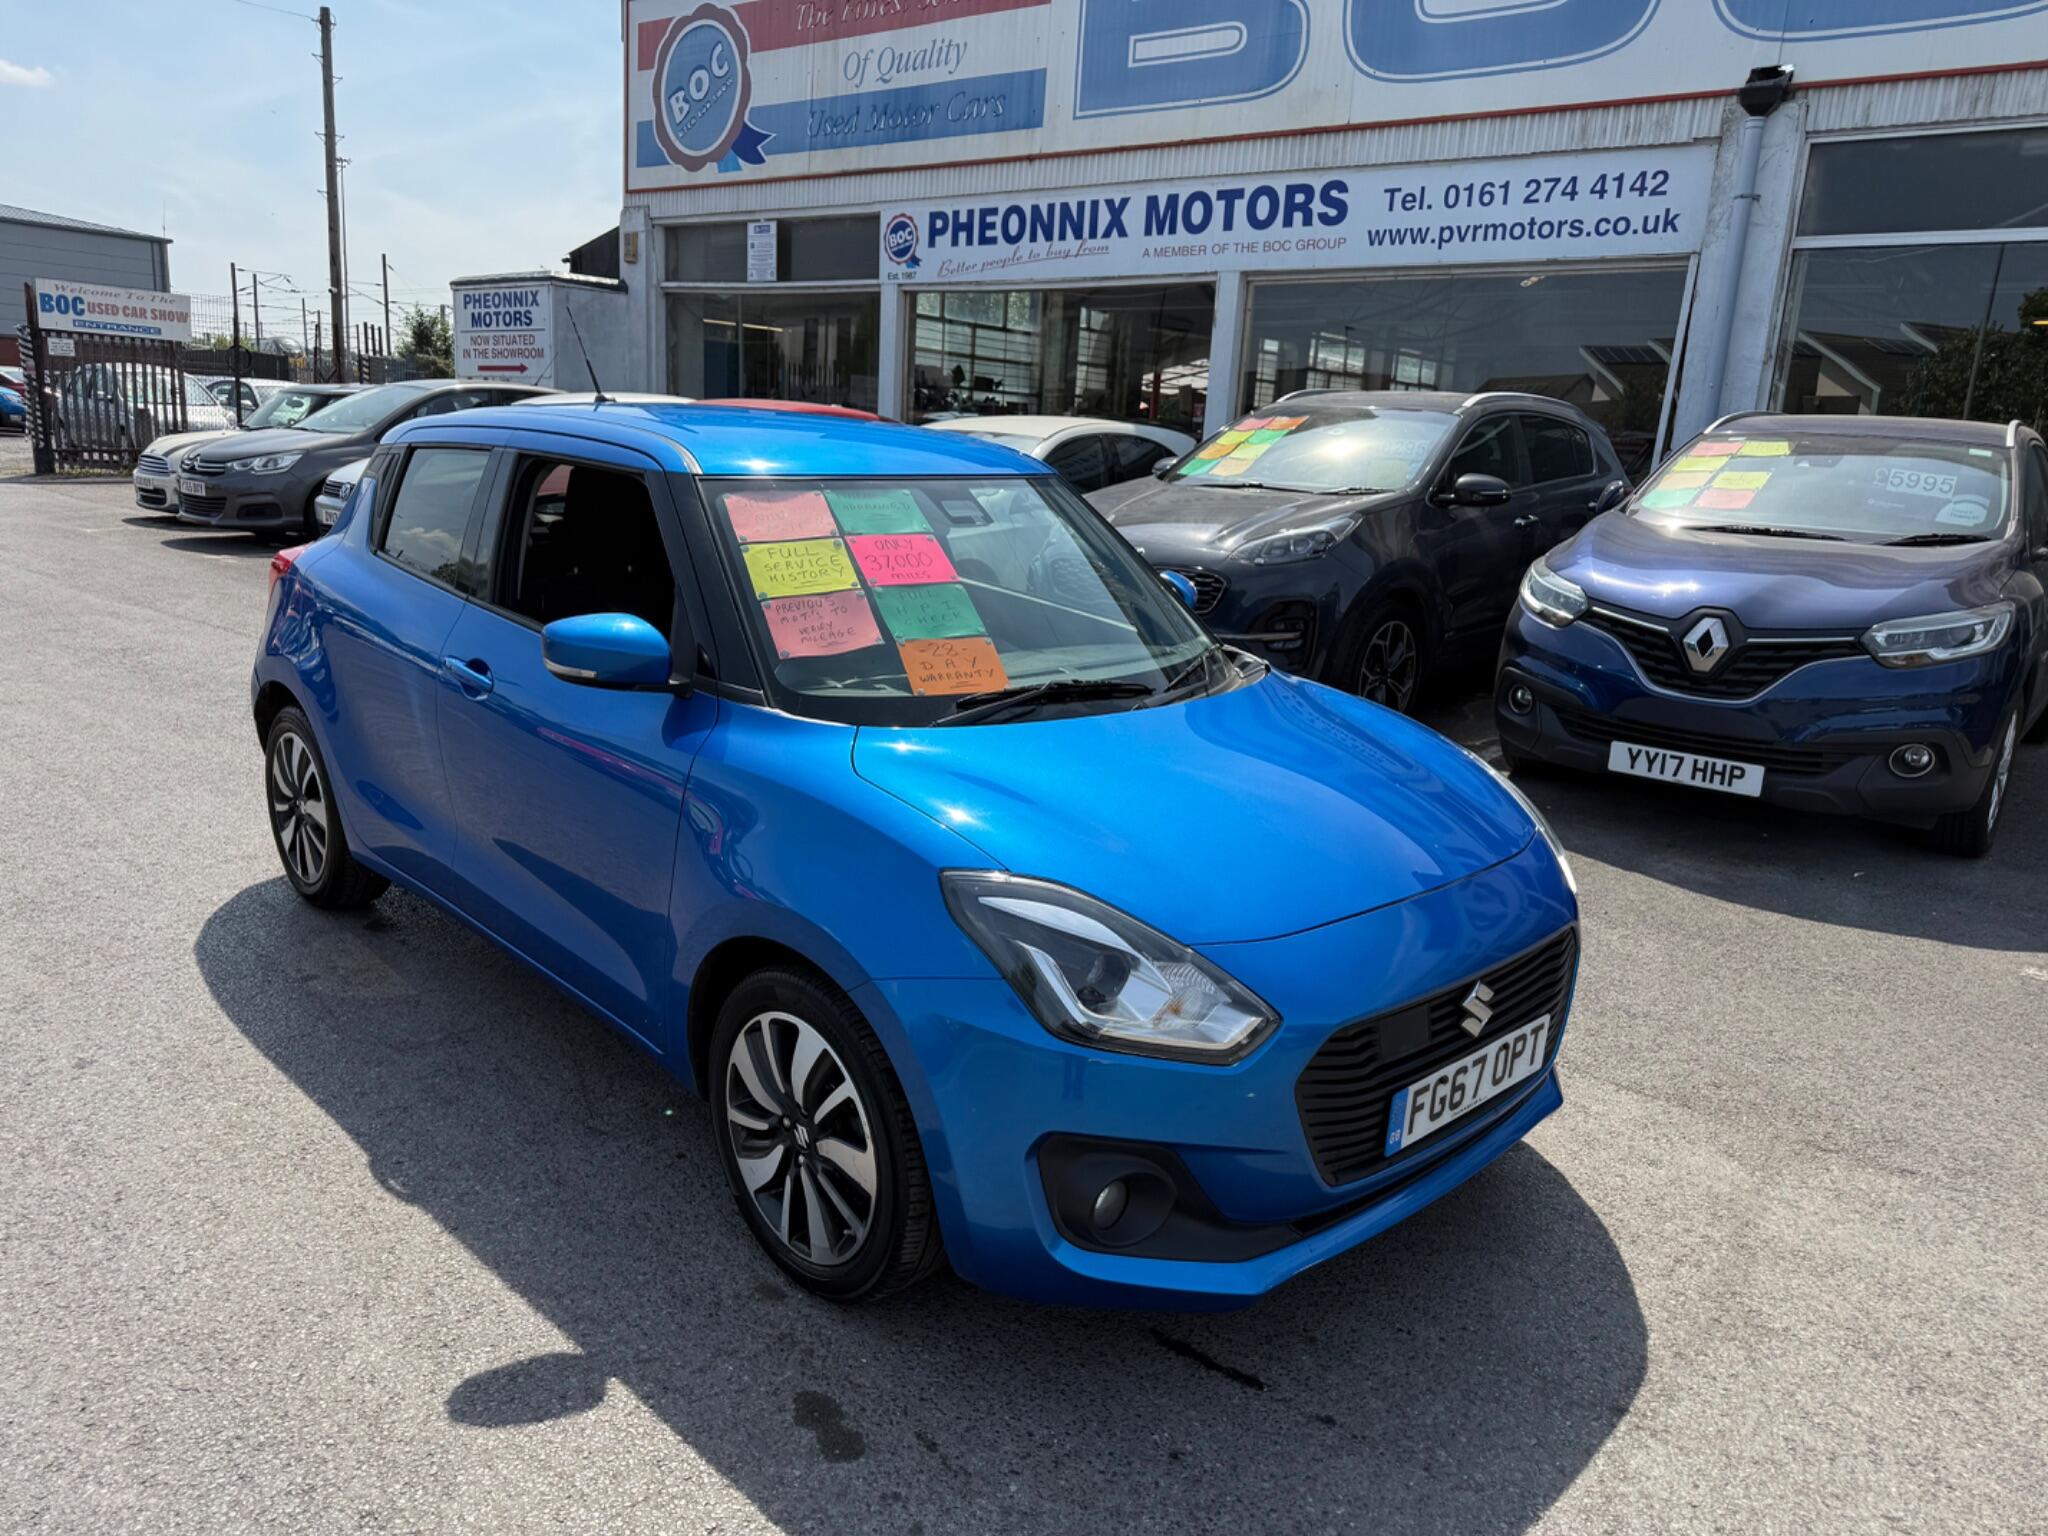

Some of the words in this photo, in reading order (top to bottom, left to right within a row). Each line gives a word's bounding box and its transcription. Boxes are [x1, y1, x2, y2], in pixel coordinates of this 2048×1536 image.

[796, 3, 834, 31] The
[843, 49, 873, 88] Of
[875, 38, 967, 84] Quality
[669, 41, 729, 126] BOC
[807, 105, 860, 138] Used
[865, 101, 940, 133] Motor
[947, 91, 1006, 124] Cars
[1384, 186, 1432, 212] Tel.
[1444, 180, 1511, 209] 0161
[1523, 176, 1579, 204] 274
[1590, 170, 1670, 200] 4142
[928, 196, 1131, 248] PHEONNIX
[1144, 179, 1349, 237] MOTORS
[888, 227, 913, 246] BOC
[1367, 208, 1680, 250] www.pvrmotors.co.uk
[1142, 248, 1150, 258] A
[1154, 245, 1207, 258] MEMBER
[1212, 243, 1229, 255] OF
[1233, 242, 1258, 254] THE
[1263, 240, 1291, 252] BOC
[1296, 237, 1346, 251] GROUP
[937, 259, 977, 277] Better
[981, 247, 1023, 272] people
[1028, 248, 1040, 260] to
[1046, 242, 1070, 259] buy
[1075, 238, 1110, 257] from
[54, 284, 121, 298] Welcome
[126, 291, 145, 301] To
[150, 294, 176, 305] The
[463, 290, 539, 310] PHEONNIX
[39, 292, 86, 317] BOC
[87, 301, 119, 316] USED
[122, 305, 147, 320] CAR
[150, 308, 189, 323] SHOW
[75, 320, 160, 334] ENTRANCE
[471, 310, 533, 328] MOTORS
[470, 335, 490, 346] NOW
[493, 334, 535, 346] SITUATED
[463, 349, 471, 359] IN
[473, 348, 489, 359] THE
[491, 347, 544, 359] SHOWROOM
[767, 547, 820, 560] FULL
[874, 539, 913, 550] ONLY
[765, 554, 843, 572] SERVICE
[865, 552, 933, 571] 37,000
[769, 567, 845, 583] HISTORY
[776, 596, 836, 614] PREVIOUS
[832, 606, 847, 616] TO
[801, 627, 855, 643] MILEAGE
[920, 669, 993, 682] WARRANTY
[1628, 747, 1685, 777] YY17
[1691, 759, 1746, 787] HHP
[1407, 1054, 1488, 1137] FG67
[1491, 1023, 1545, 1087] OPT
